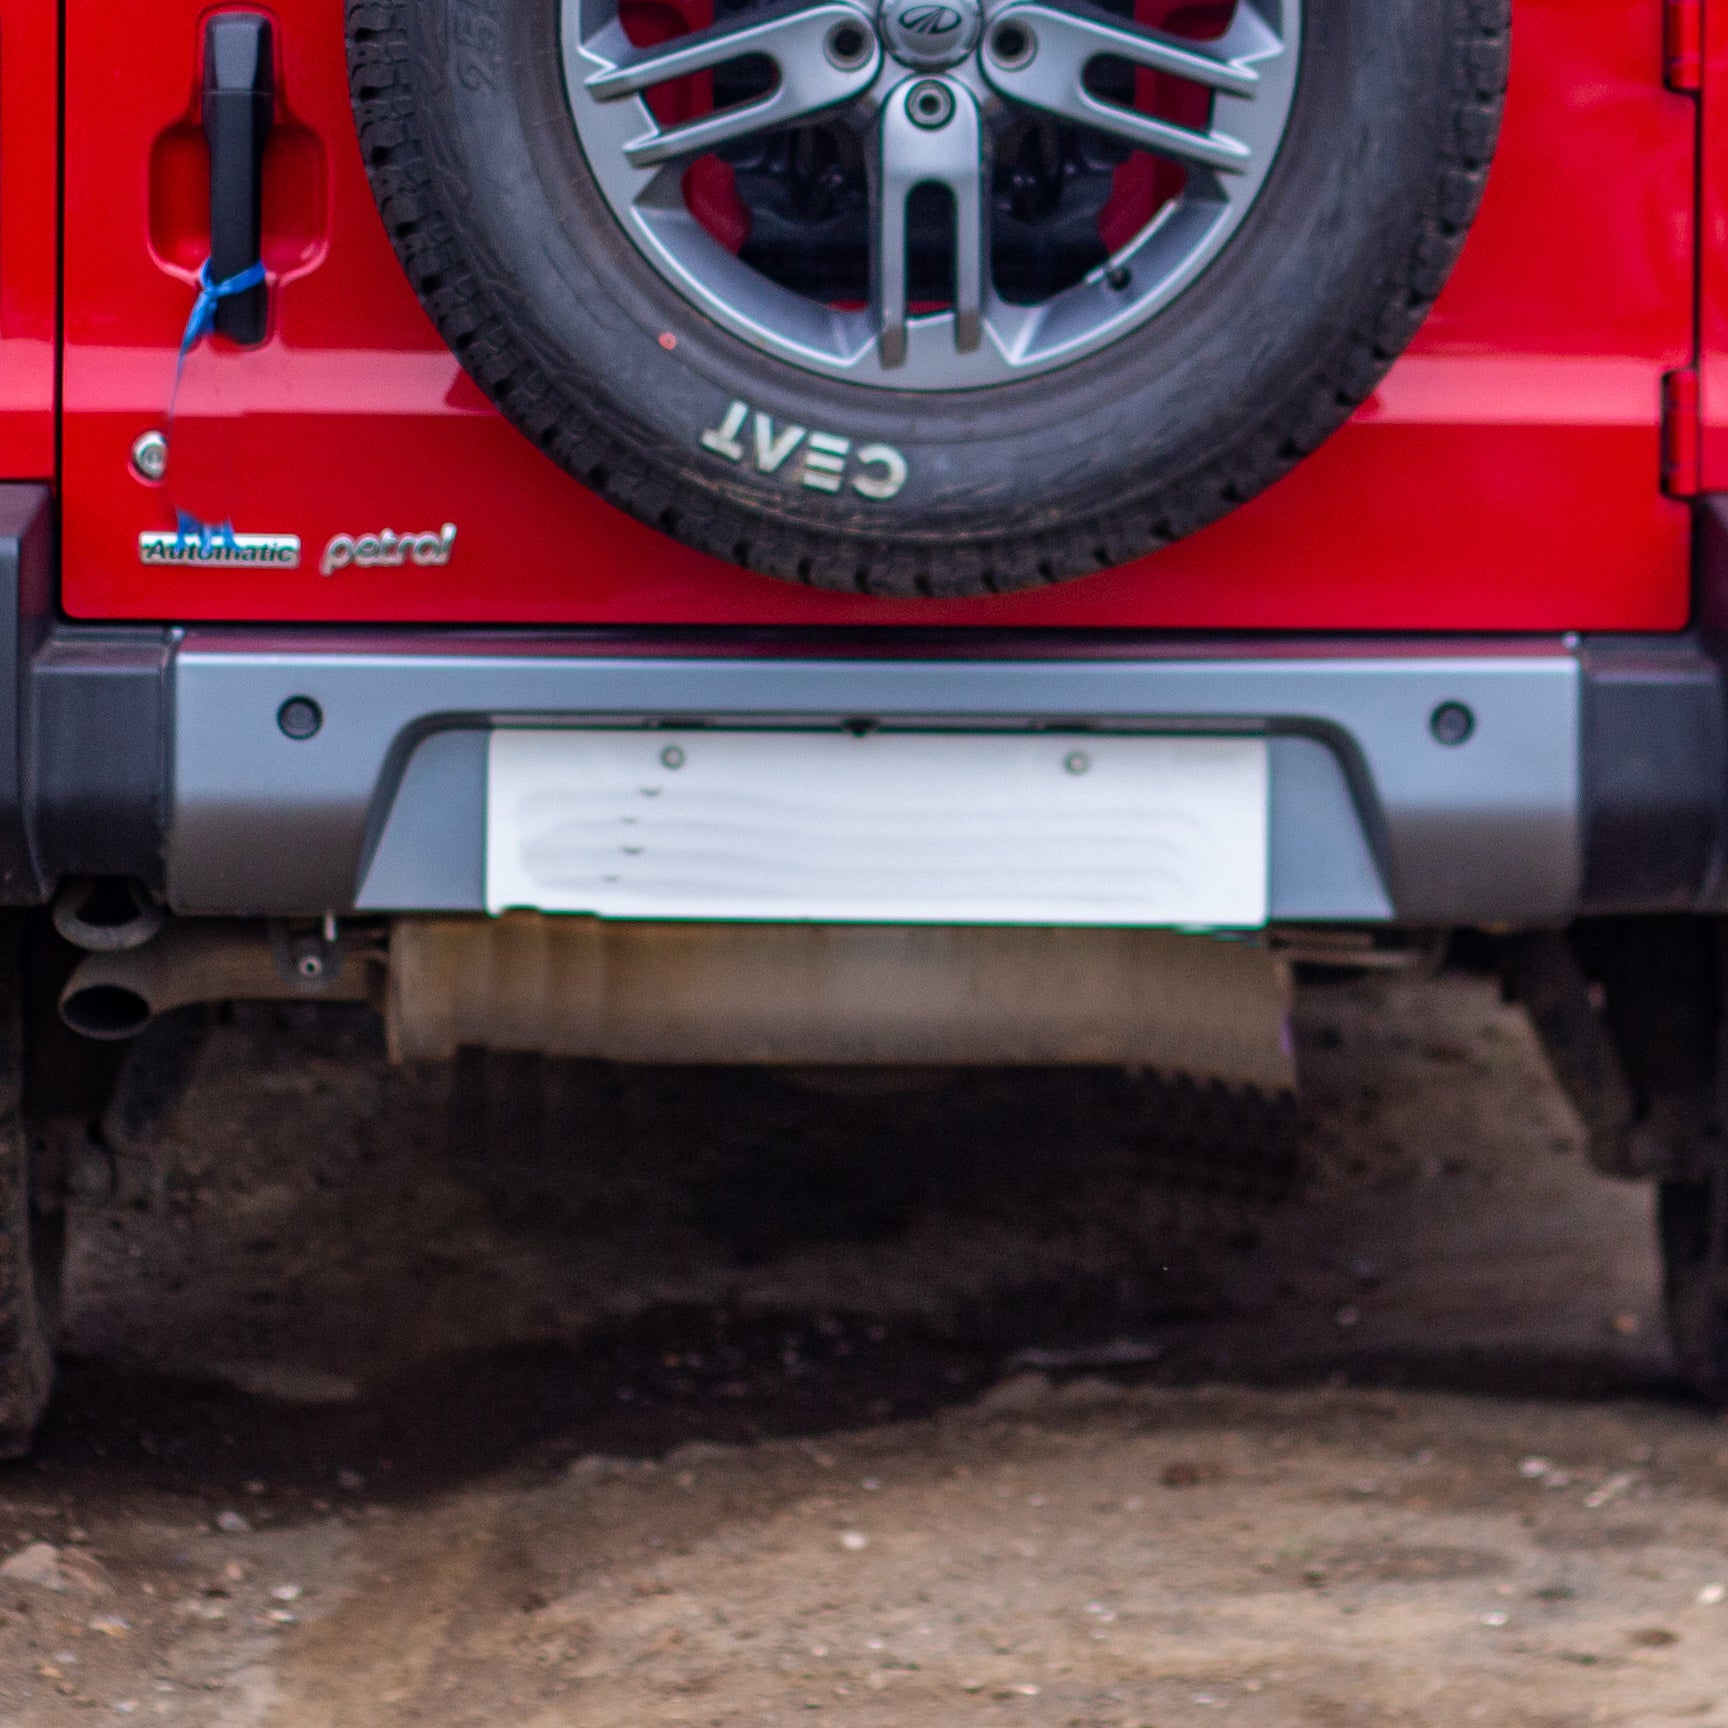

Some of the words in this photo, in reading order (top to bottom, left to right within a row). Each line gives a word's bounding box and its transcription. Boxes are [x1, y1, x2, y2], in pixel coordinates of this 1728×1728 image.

[700, 399, 909, 501] CEAT
[144, 537, 297, 563] Automatic
[320, 521, 458, 576] petrol
